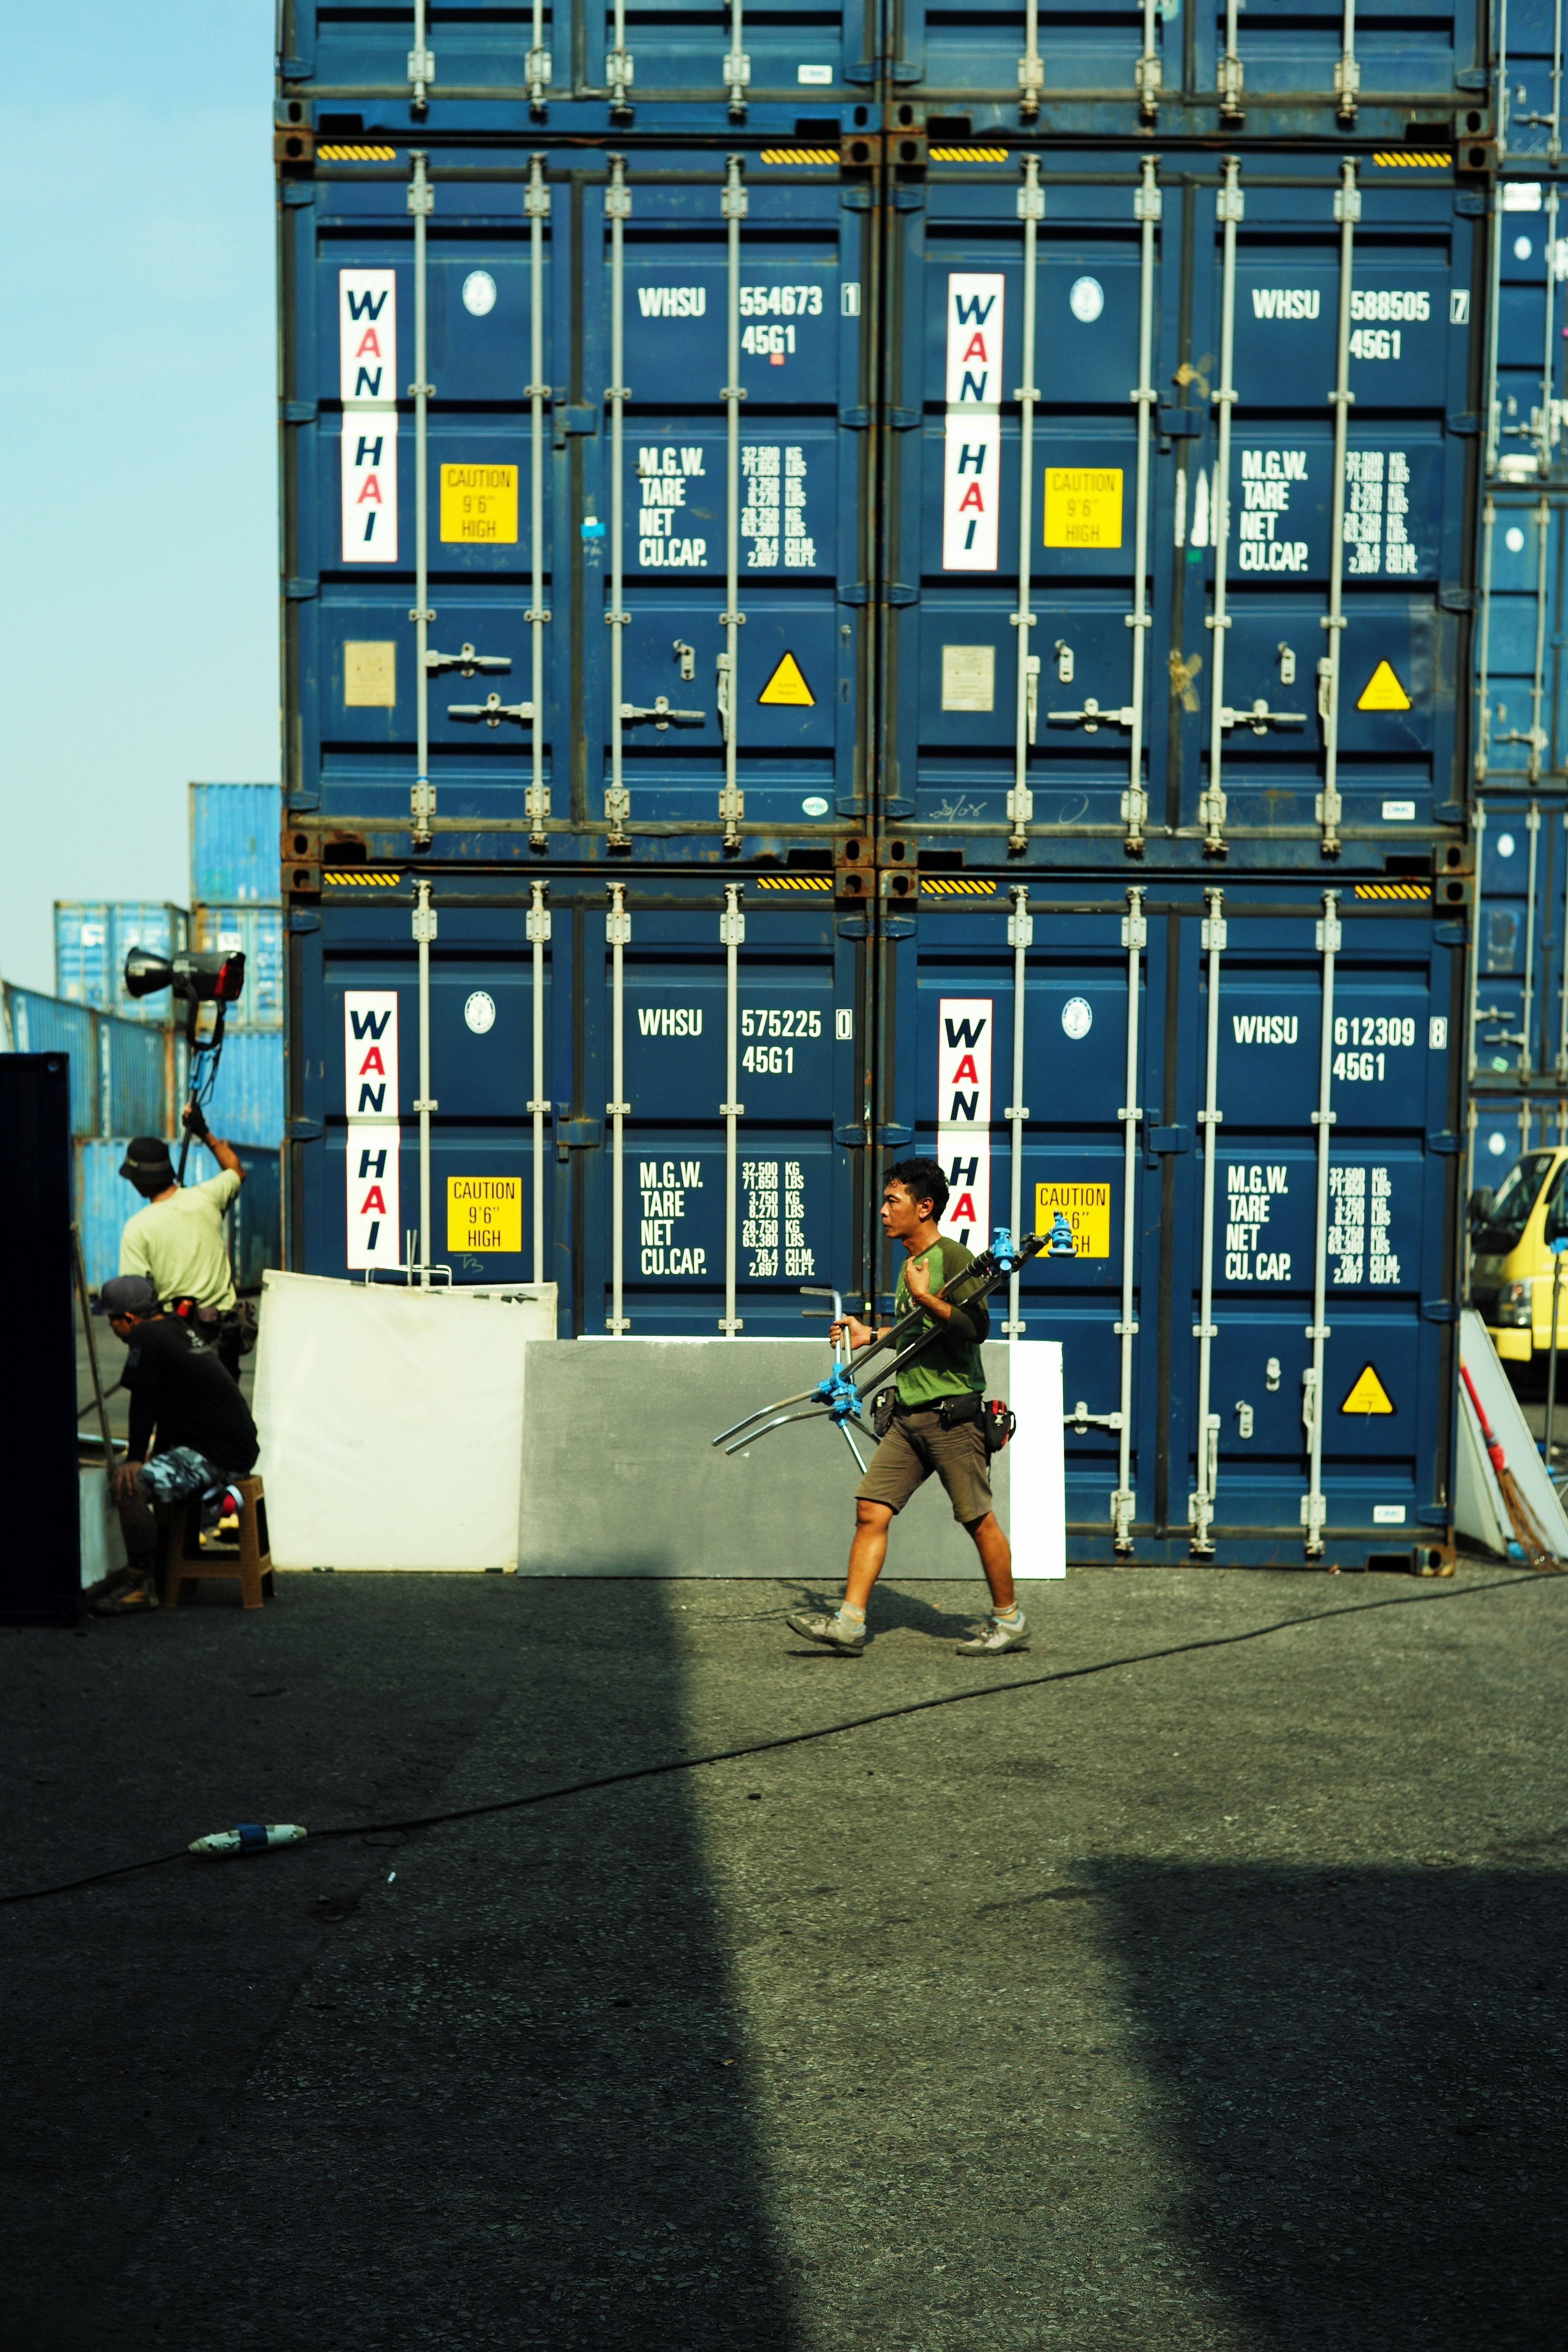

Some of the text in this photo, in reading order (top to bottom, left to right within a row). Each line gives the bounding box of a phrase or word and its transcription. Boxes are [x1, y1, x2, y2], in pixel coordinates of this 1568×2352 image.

[638, 287, 706, 317] WHSU
[740, 286, 823, 316] 554673
[1252, 289, 1468, 322] WHSU 588505 7
[741, 325, 795, 354] 45G1
[1349, 329, 1401, 359] 45G1
[347, 291, 388, 541] WAN HAI
[956, 295, 995, 549] WAN HAI
[639, 447, 705, 476] M.G.W.
[1242, 450, 1308, 480] M.G.W.
[447, 469, 511, 488] CAUTION
[639, 478, 686, 506] TARE
[1052, 474, 1115, 491] CAUTION
[1242, 481, 1290, 510] TARE
[462, 520, 496, 537] HIGH
[639, 508, 675, 536] NET
[1066, 525, 1100, 542] HIGH
[1240, 511, 1279, 540] NET
[639, 538, 707, 567] CU.CAP.
[1239, 542, 1308, 571] CU.CAP.
[638, 1008, 702, 1036] WHSU
[742, 1009, 821, 1037] 575225
[1233, 1016, 1446, 1048] WHSU 612309 8
[742, 1046, 793, 1074] 45G1
[944, 1018, 987, 1121] WAN
[1332, 1052, 1385, 1081] 45G1
[350, 1010, 392, 1250] WAN HAI
[640, 1161, 703, 1188] M.G.W.
[742, 1162, 800, 1176] 32,500 KG
[1228, 1165, 1288, 1194] M.G.W.
[1372, 1167, 1387, 1182] KG
[454, 1182, 515, 1199] CAUTION
[742, 1176, 805, 1190] 71,650 LBS
[1040, 1187, 1106, 1206] CAUTION
[1372, 1181, 1391, 1197] LBS
[641, 1190, 685, 1217] TARE
[749, 1191, 800, 1206] 3,750 KG
[749, 1204, 805, 1219] 8,270 LBS
[1227, 1195, 1270, 1222] TARE
[1371, 1197, 1387, 1211] KG
[743, 1219, 800, 1234] 28,750 KG
[1371, 1210, 1391, 1226] LBS
[468, 1229, 501, 1247] HIGH
[641, 1219, 674, 1246] NET
[743, 1233, 805, 1248] 63,380 LBS
[1226, 1223, 1261, 1251] NET
[1370, 1226, 1386, 1240] KG
[755, 1249, 815, 1263] 76.4 CU.M.
[1370, 1240, 1390, 1255] LBS
[641, 1248, 707, 1275] CU.CAP.
[749, 1262, 815, 1277] 2,697 CU.FT.
